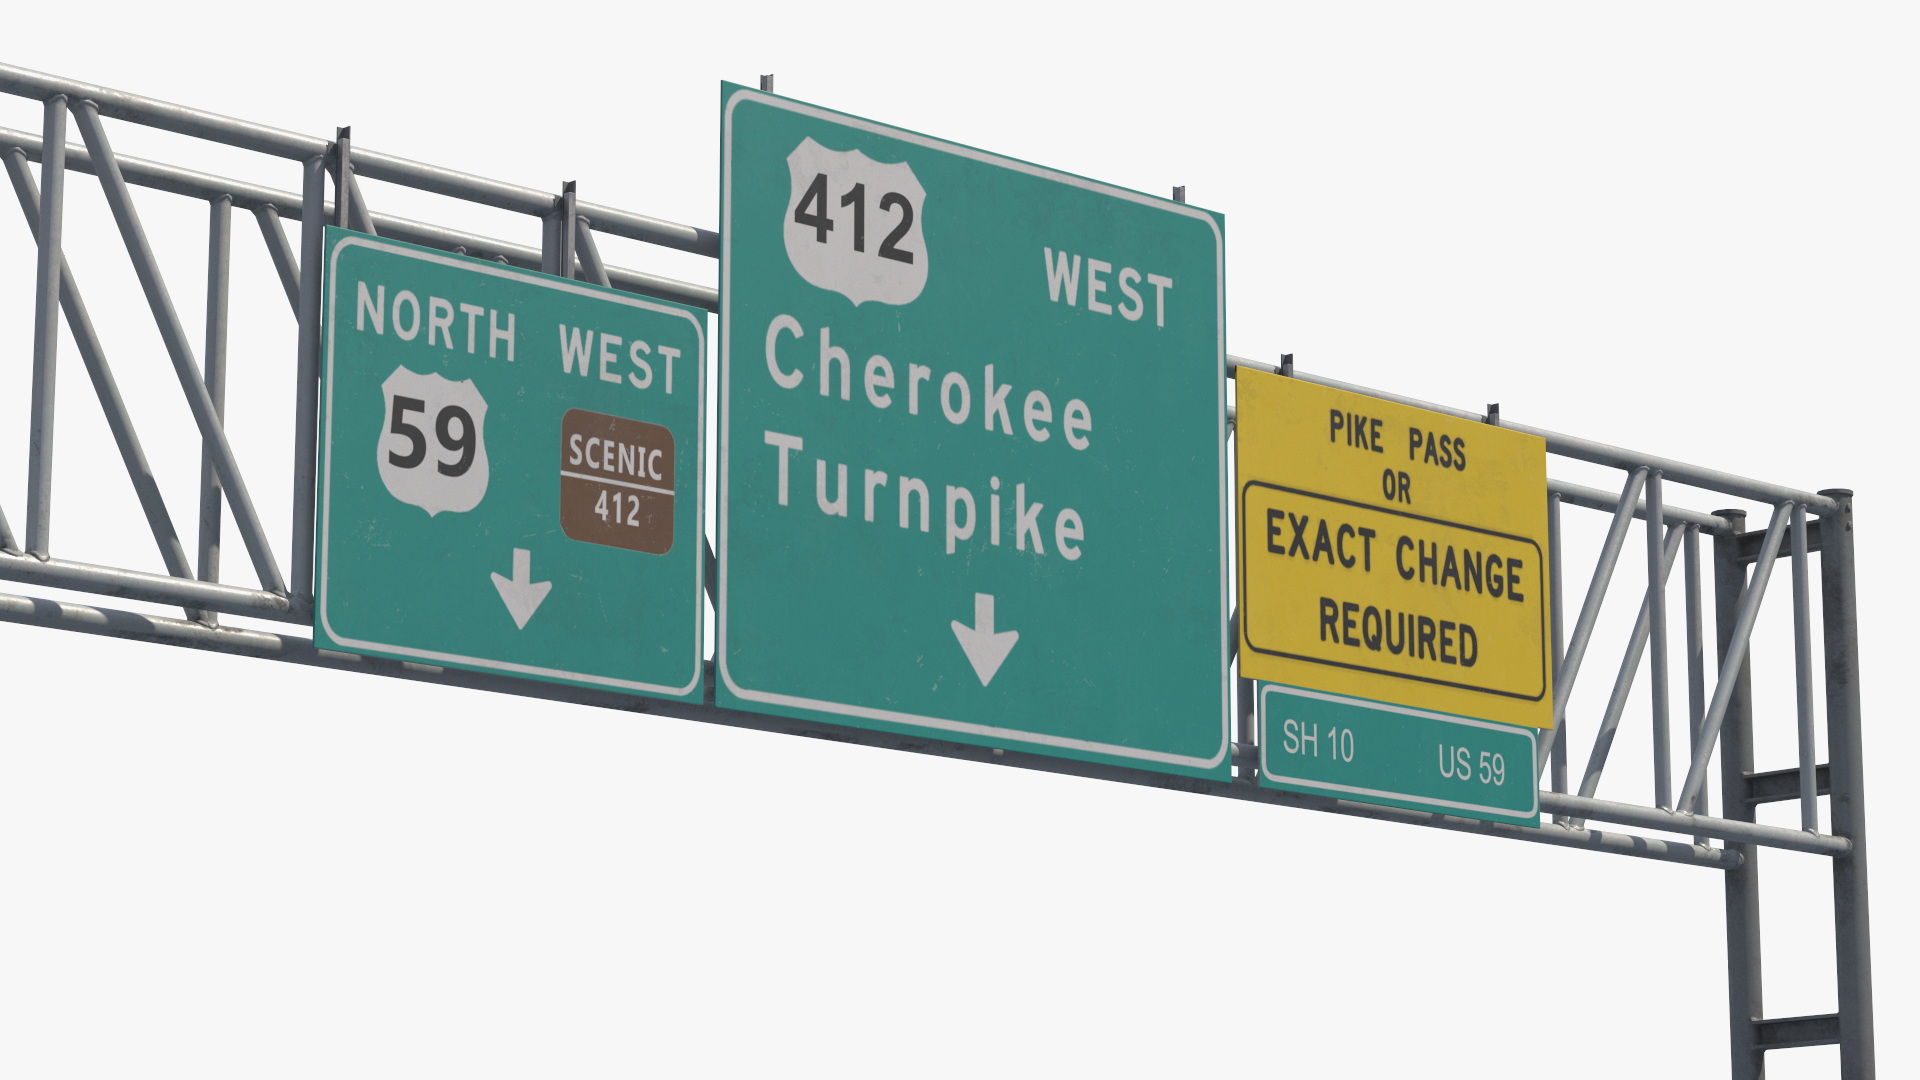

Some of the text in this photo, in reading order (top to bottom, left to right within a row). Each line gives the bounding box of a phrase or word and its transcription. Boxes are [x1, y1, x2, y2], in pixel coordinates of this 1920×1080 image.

[795, 172, 914, 265] 412
[356, 280, 516, 363] NORTH
[1043, 246, 1174, 328] WEST
[558, 323, 682, 395] WEST
[764, 313, 1093, 452] Cherokee
[388, 394, 477, 478] 59
[569, 433, 664, 482] SCENIC
[1330, 408, 1467, 472] PIKE PASS
[594, 489, 640, 527] 412
[763, 429, 1085, 561] Turnpike
[1382, 468, 1412, 505] OR
[1266, 507, 1525, 603] EXACT CHANGE
[1319, 596, 1478, 668] REQUIRED
[1282, 718, 1355, 763] SH 10
[1438, 743, 1506, 787] US 59
